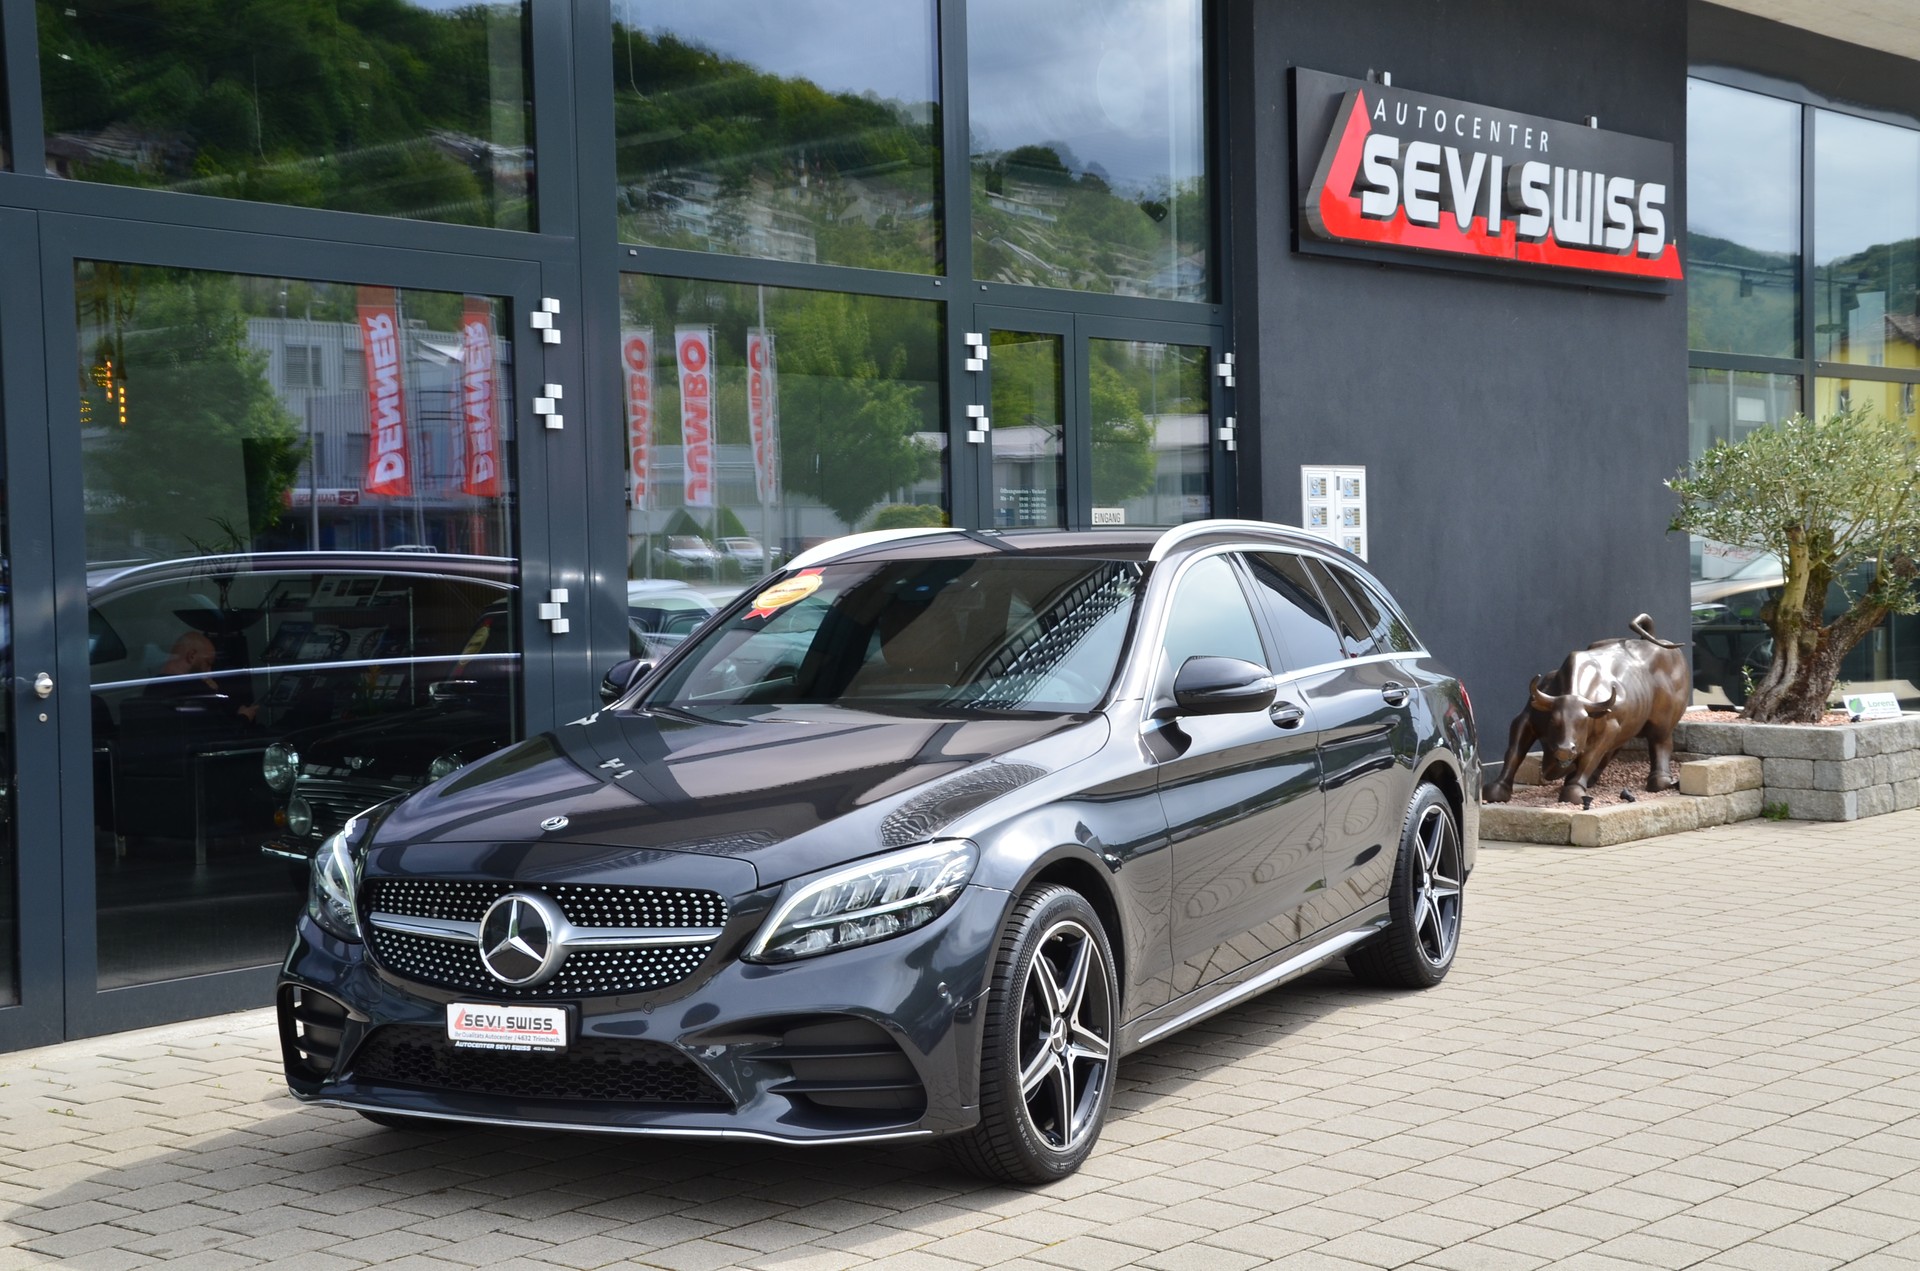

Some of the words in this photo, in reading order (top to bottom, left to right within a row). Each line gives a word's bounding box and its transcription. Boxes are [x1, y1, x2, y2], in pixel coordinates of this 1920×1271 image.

[1373, 97, 1549, 152] AUTOCENTER
[1361, 133, 1503, 233] SEVI
[1518, 160, 1666, 255] SWISS
[1094, 512, 1121, 524] EINGANG
[1867, 700, 1896, 708] Lorenz
[464, 1013, 502, 1029] SEVI
[506, 1016, 553, 1031] SWISS
[485, 1033, 513, 1041] Autocenter
[533, 1035, 561, 1043] Trimbach
